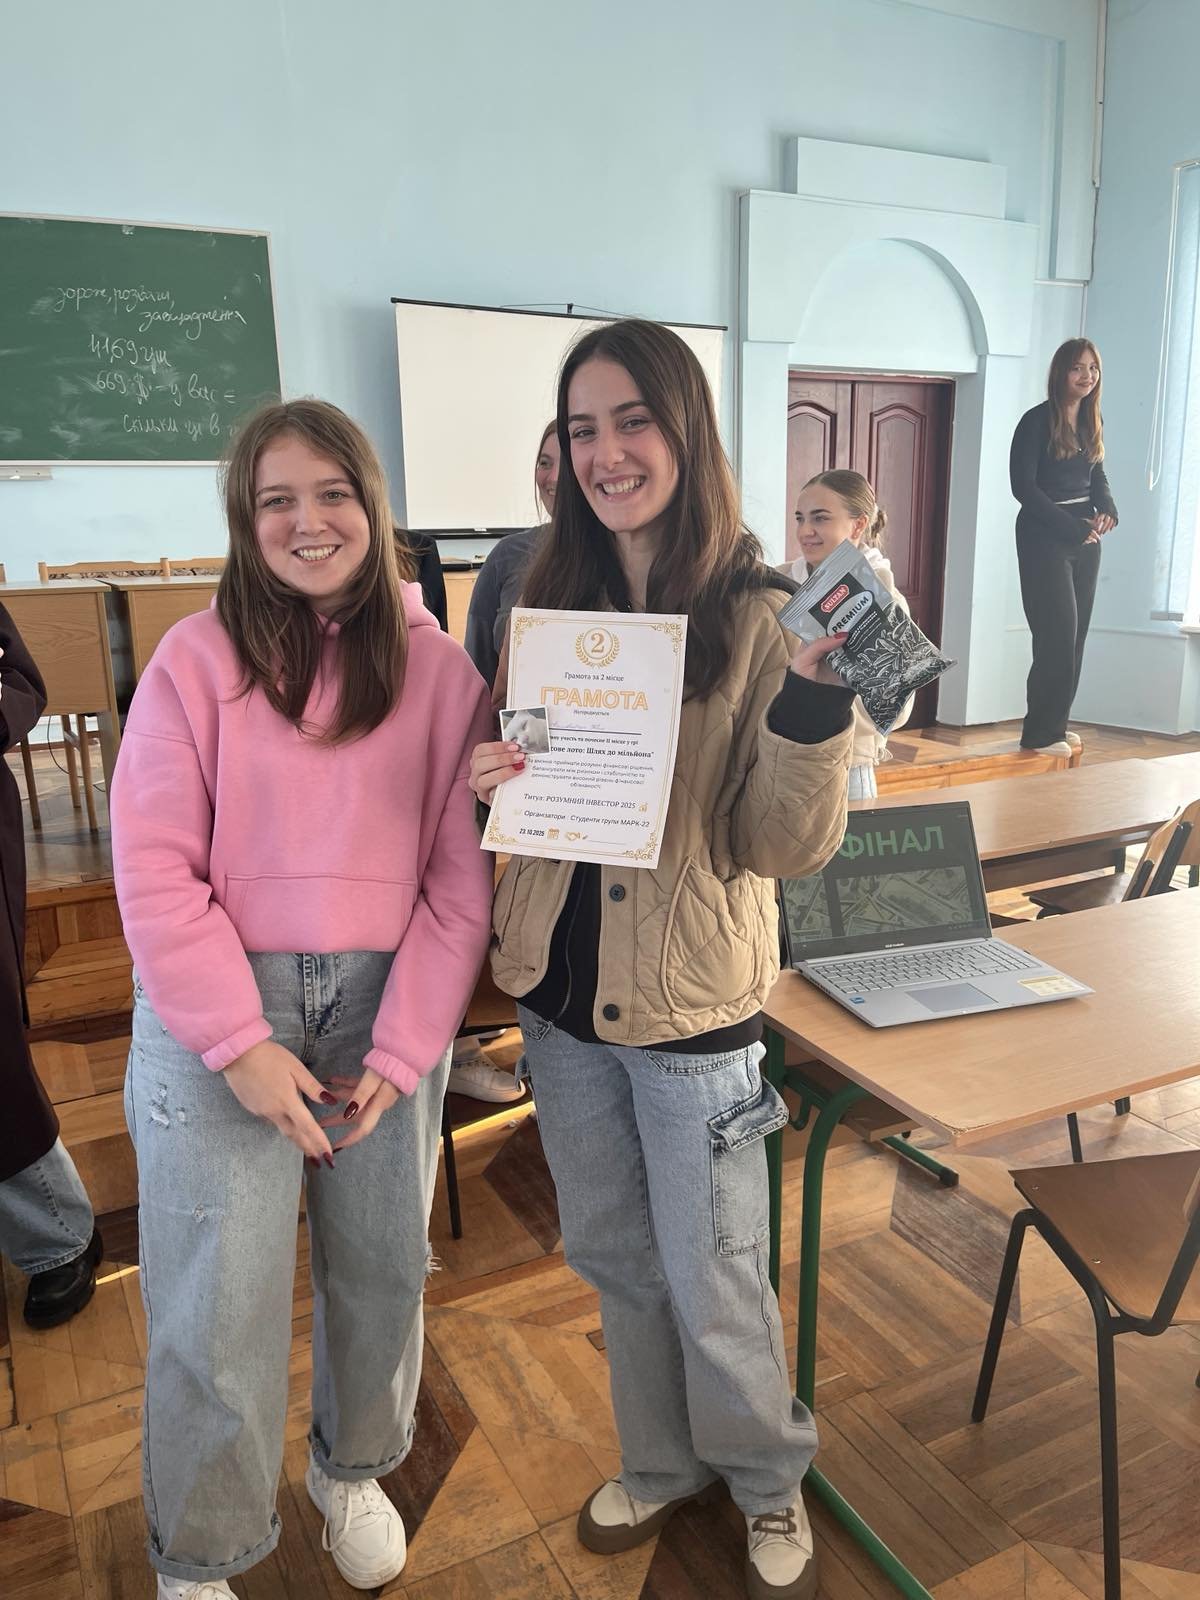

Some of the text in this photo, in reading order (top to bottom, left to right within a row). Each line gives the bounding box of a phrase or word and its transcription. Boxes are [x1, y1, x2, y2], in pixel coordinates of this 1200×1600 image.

[823, 586, 848, 610] SULTAN
[832, 595, 870, 633] PREMIUM
[591, 632, 605, 654] 2
[565, 672, 591, 682] Грамота
[606, 675, 625, 683] місце
[540, 686, 649, 711] ГРАМОТА
[586, 746, 606, 755] Шлях
[524, 793, 545, 803] Титул:
[545, 795, 586, 805] РОЗУМНИЙ
[585, 799, 620, 808] ІНВЕСТОР
[524, 810, 650, 828] Організатори Студенти групи МАРК-22
[836, 826, 945, 859] ФІНАЛ
